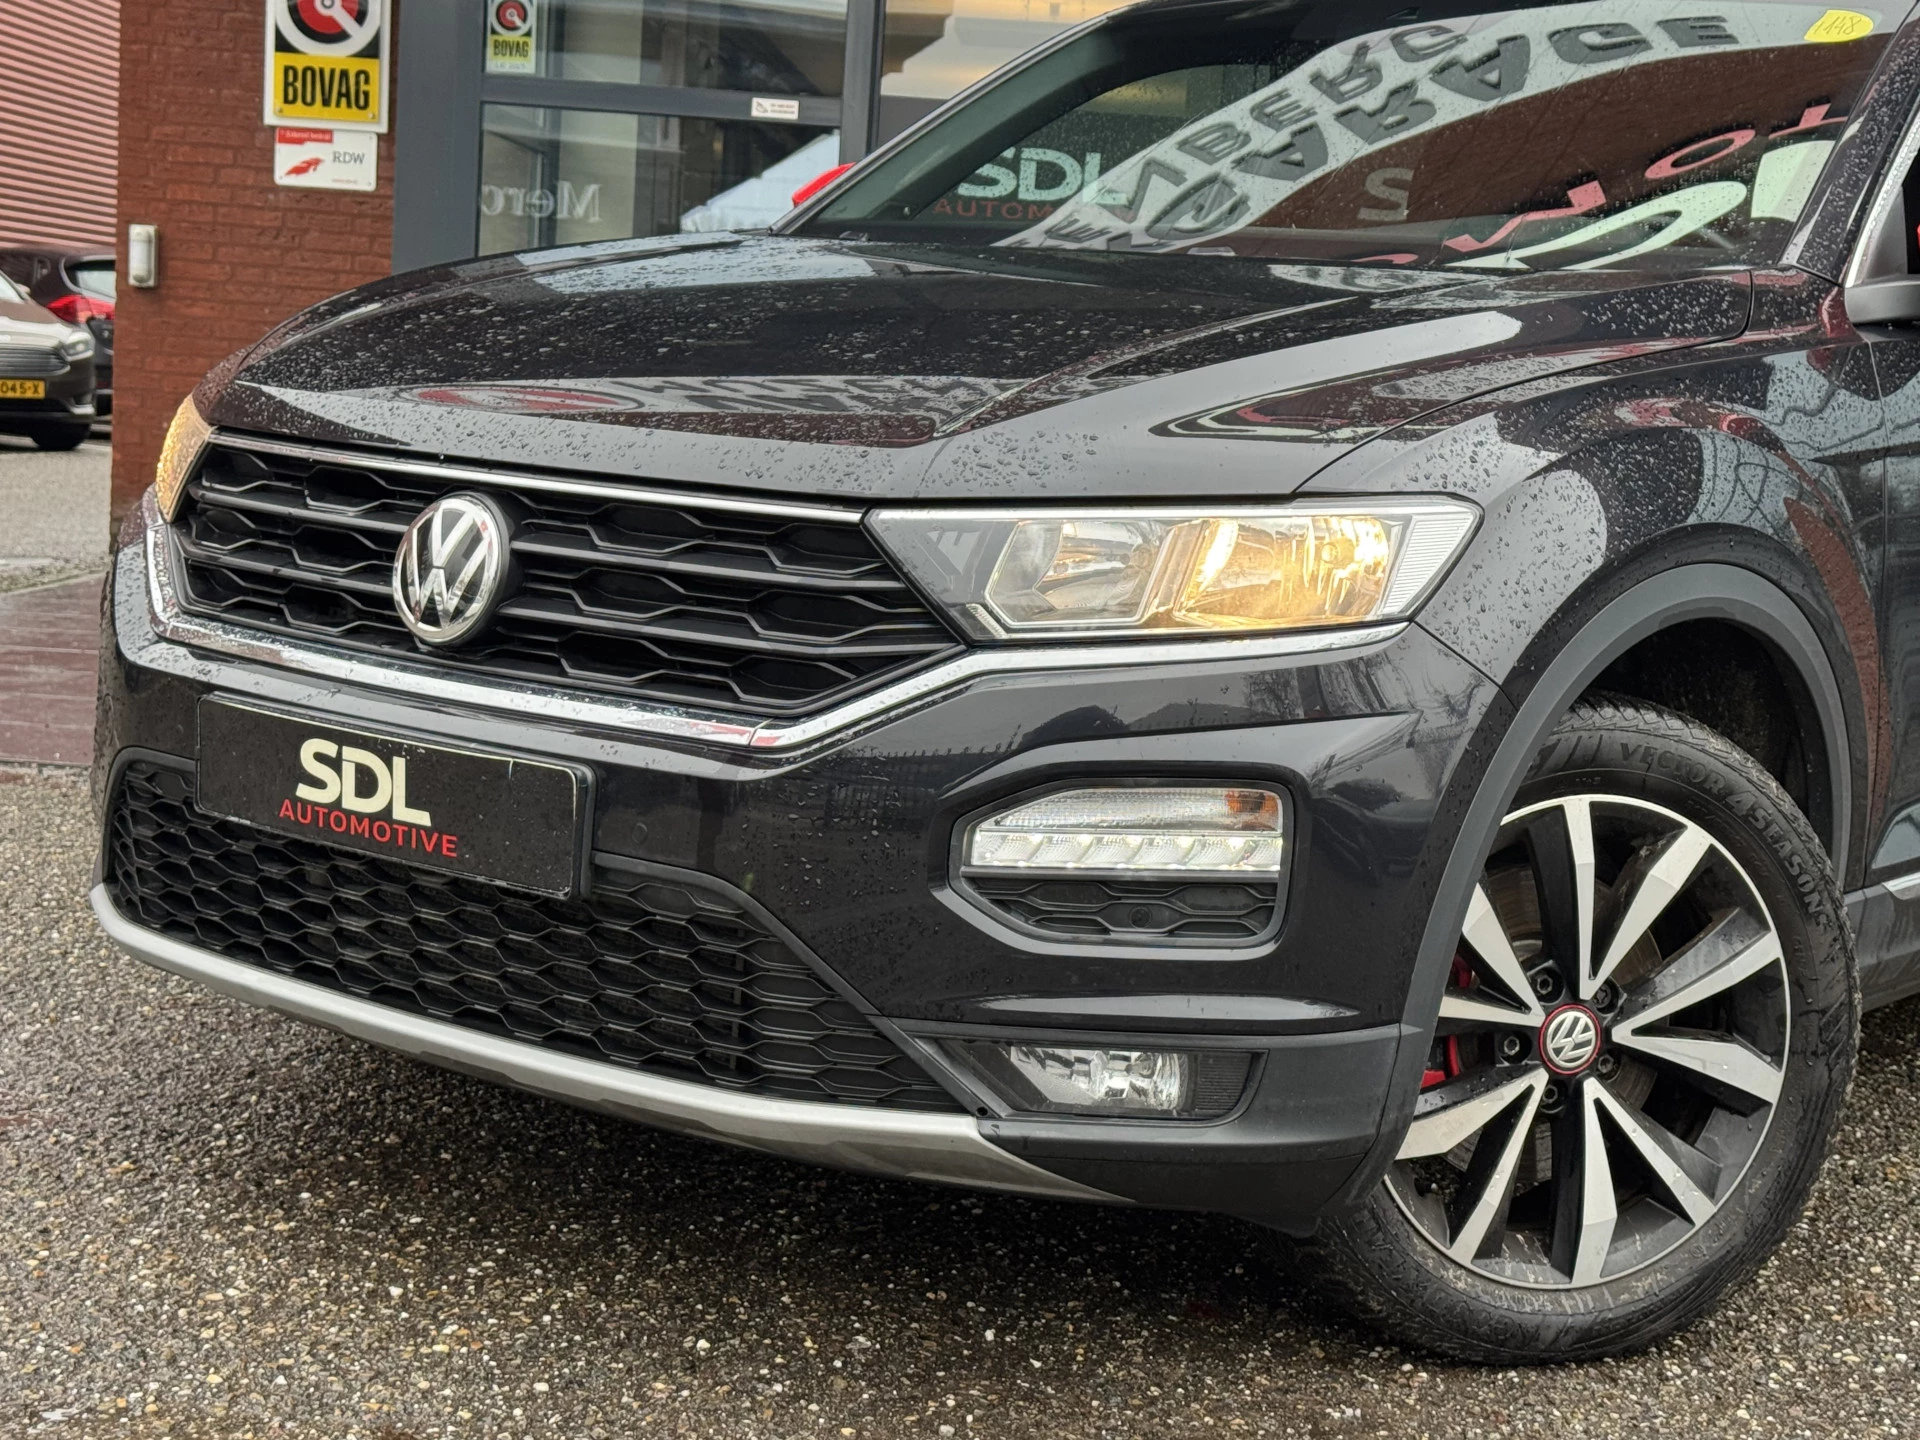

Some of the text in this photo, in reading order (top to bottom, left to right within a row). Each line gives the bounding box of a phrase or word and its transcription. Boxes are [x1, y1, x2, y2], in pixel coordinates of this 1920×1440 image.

[493, 39, 529, 58] BOVAG
[283, 64, 370, 111] BOVAG
[333, 151, 365, 164] RDW
[957, 146, 1129, 206] SDL
[295, 738, 432, 827] SDL
[1620, 742, 1728, 796] VECTOR
[279, 798, 458, 858] AUTOMOTIVE
